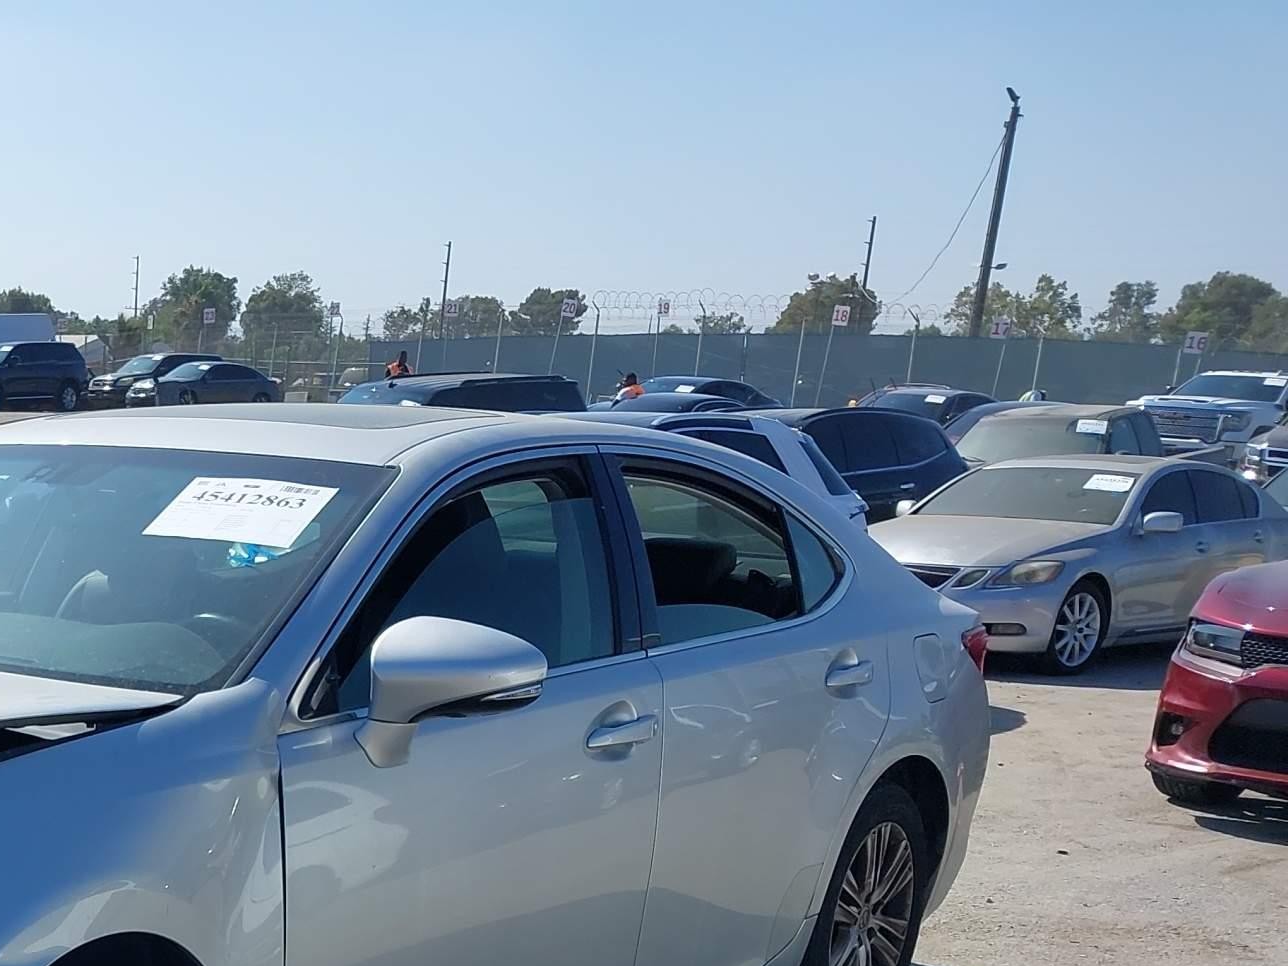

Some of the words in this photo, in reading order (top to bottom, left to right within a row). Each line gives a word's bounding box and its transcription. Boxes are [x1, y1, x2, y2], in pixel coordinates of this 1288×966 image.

[447, 303, 458, 314] 21
[562, 302, 576, 314] 20
[657, 302, 670, 314] 19
[833, 309, 848, 322] 18
[992, 322, 1009, 335] 17
[192, 490, 307, 510] 45412863
